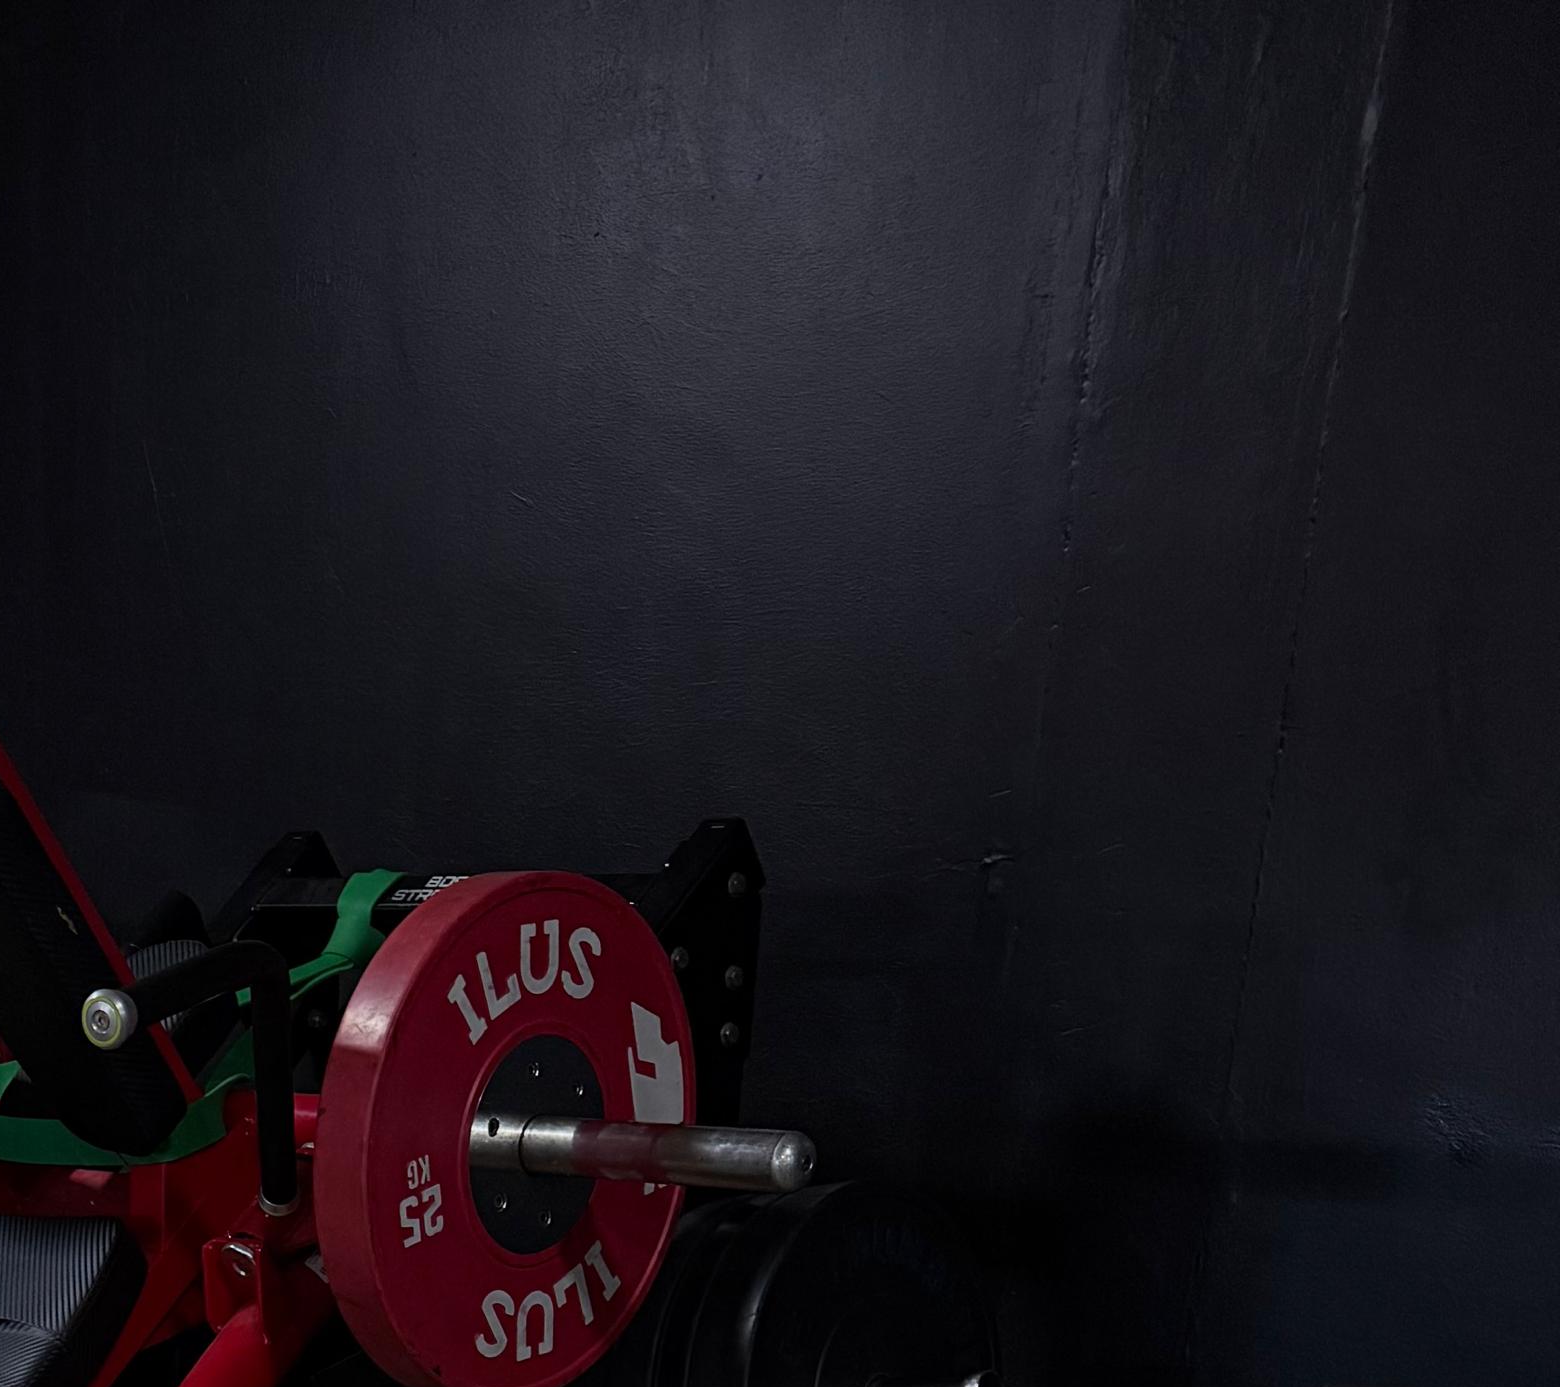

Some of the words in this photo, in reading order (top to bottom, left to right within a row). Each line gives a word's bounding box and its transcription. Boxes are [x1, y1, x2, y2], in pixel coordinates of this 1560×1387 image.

[447, 919, 602, 1046] ILUS
[399, 1183, 444, 1249] 25
[407, 1154, 431, 1190] KG
[474, 1240, 622, 1363] ILUS
